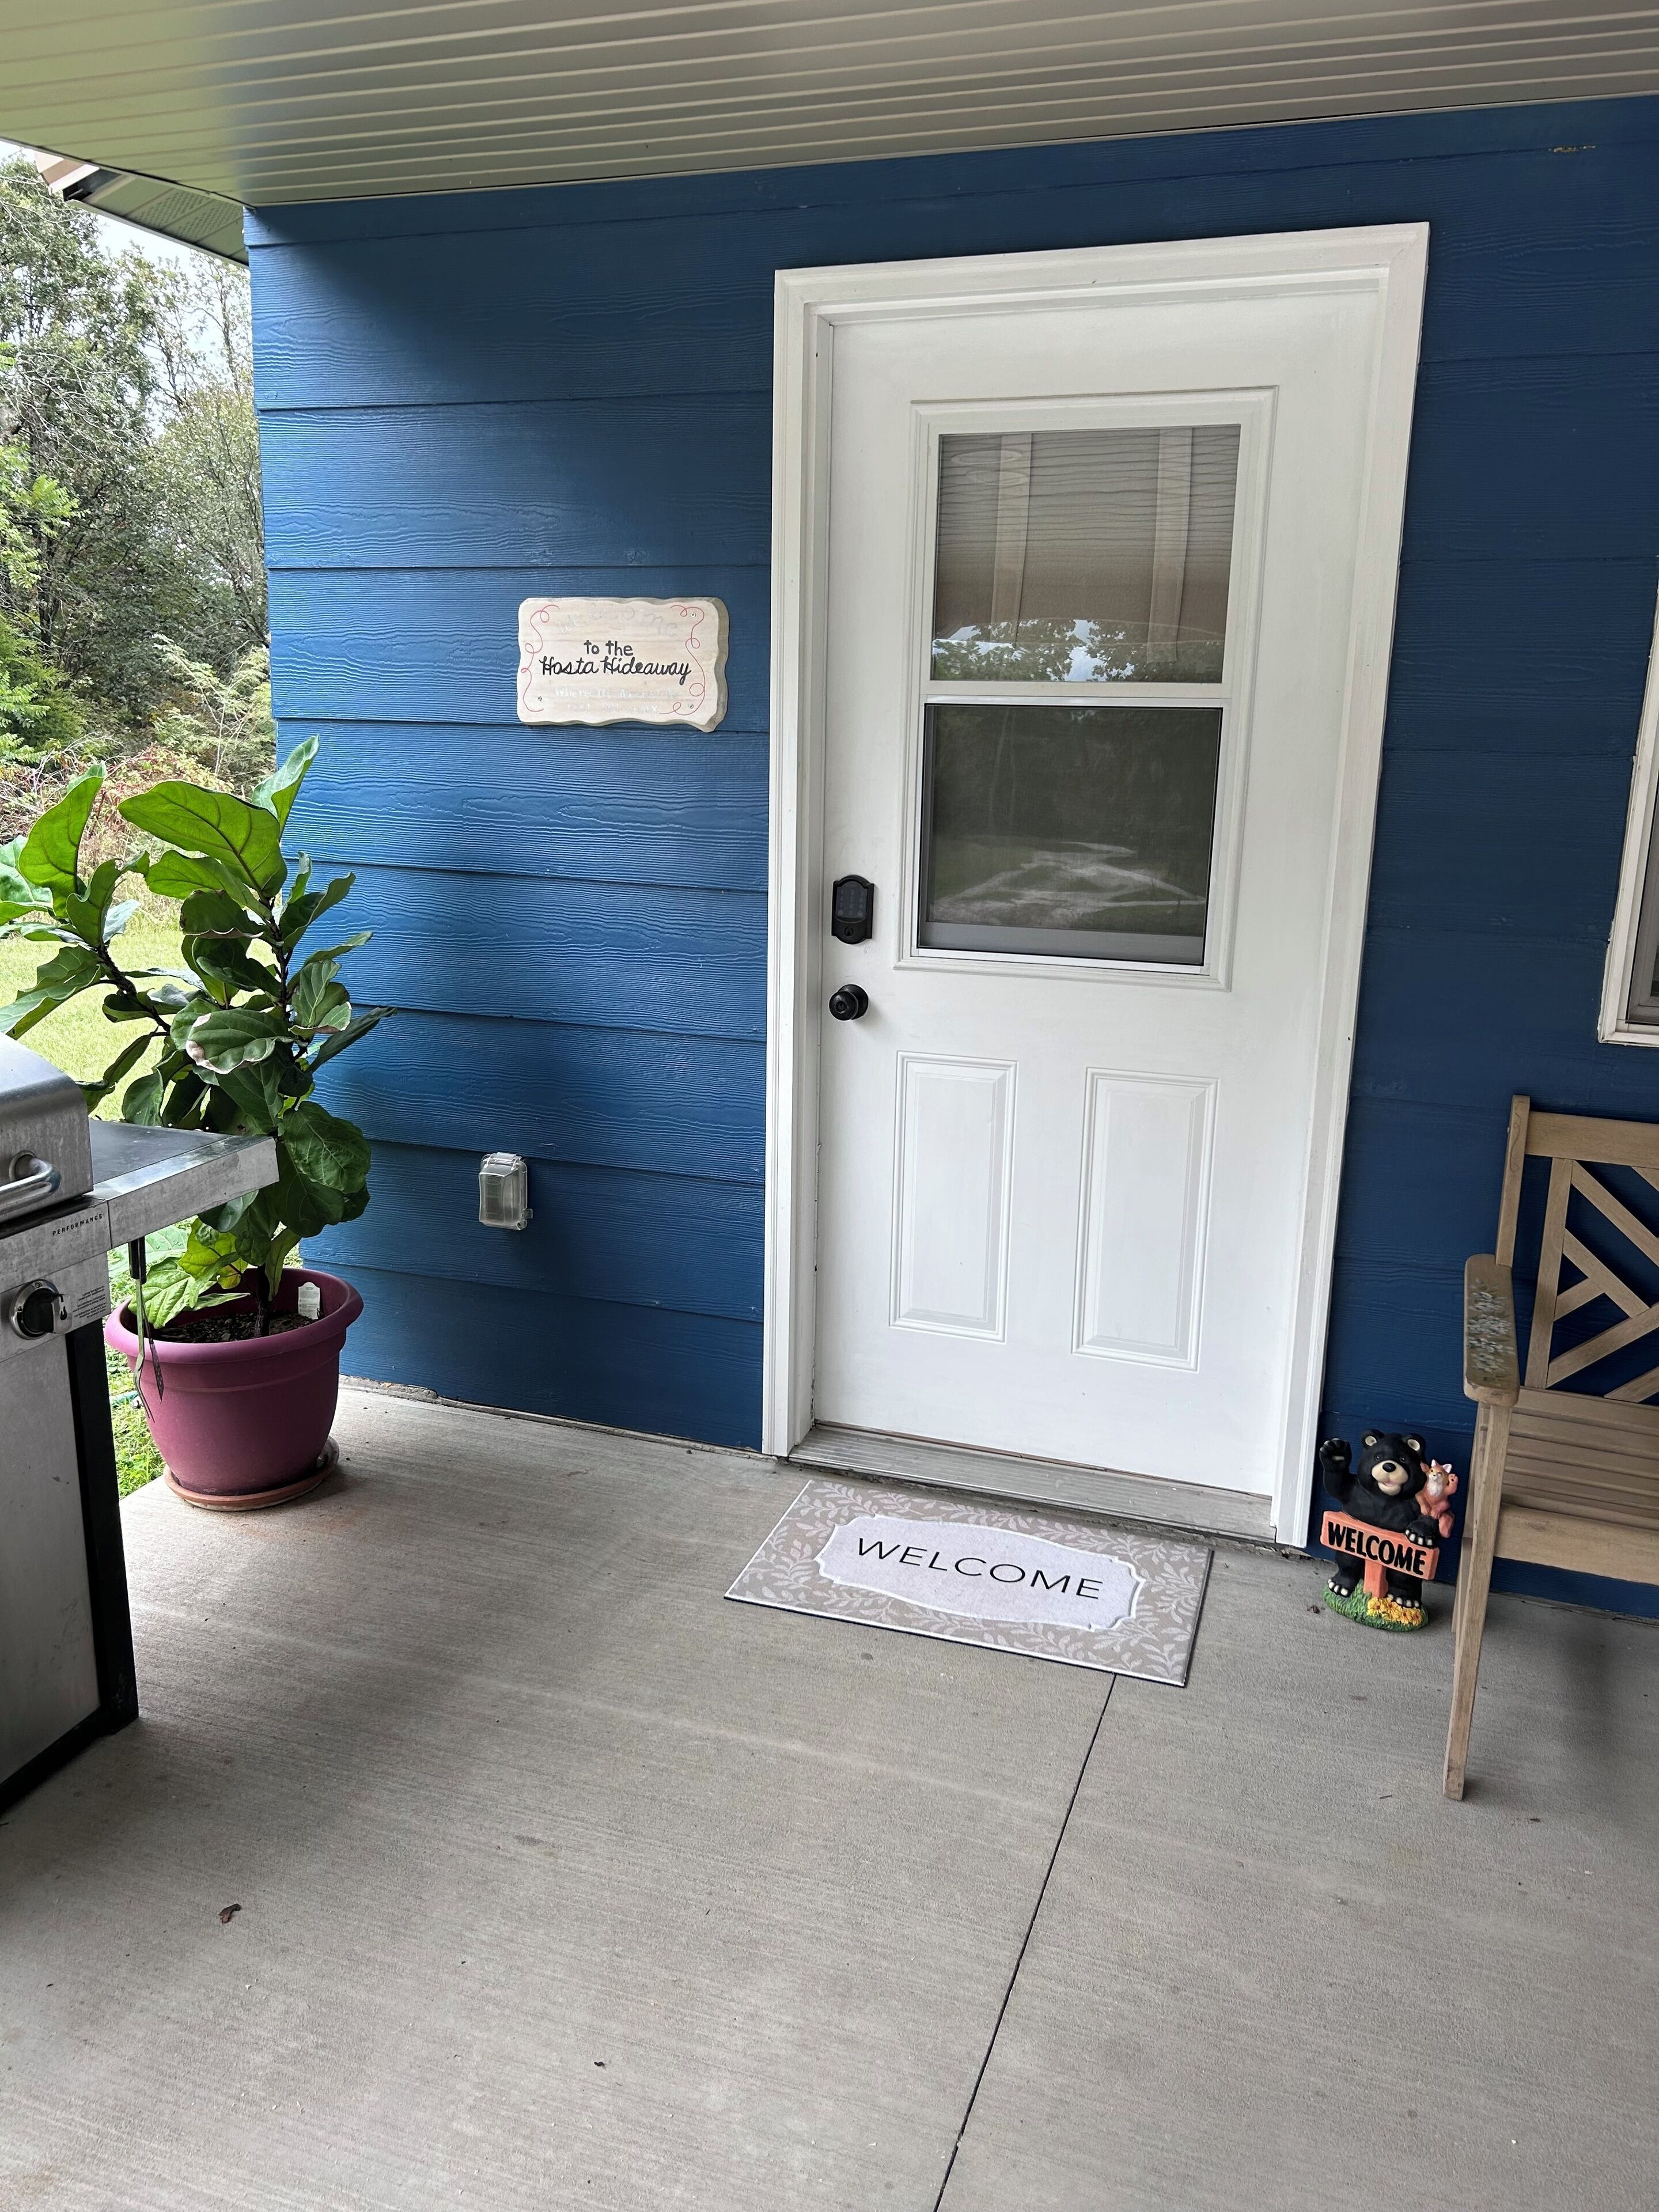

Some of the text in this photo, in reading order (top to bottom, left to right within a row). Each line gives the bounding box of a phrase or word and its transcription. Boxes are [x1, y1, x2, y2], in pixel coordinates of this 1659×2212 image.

[583, 639, 634, 656] to the
[539, 656, 692, 685] Hosta Hideaway
[52, 1213, 103, 1236] PERFORMANCE
[1328, 1521, 1427, 1575] WELCOME
[858, 1537, 1103, 1600] WELCOME
